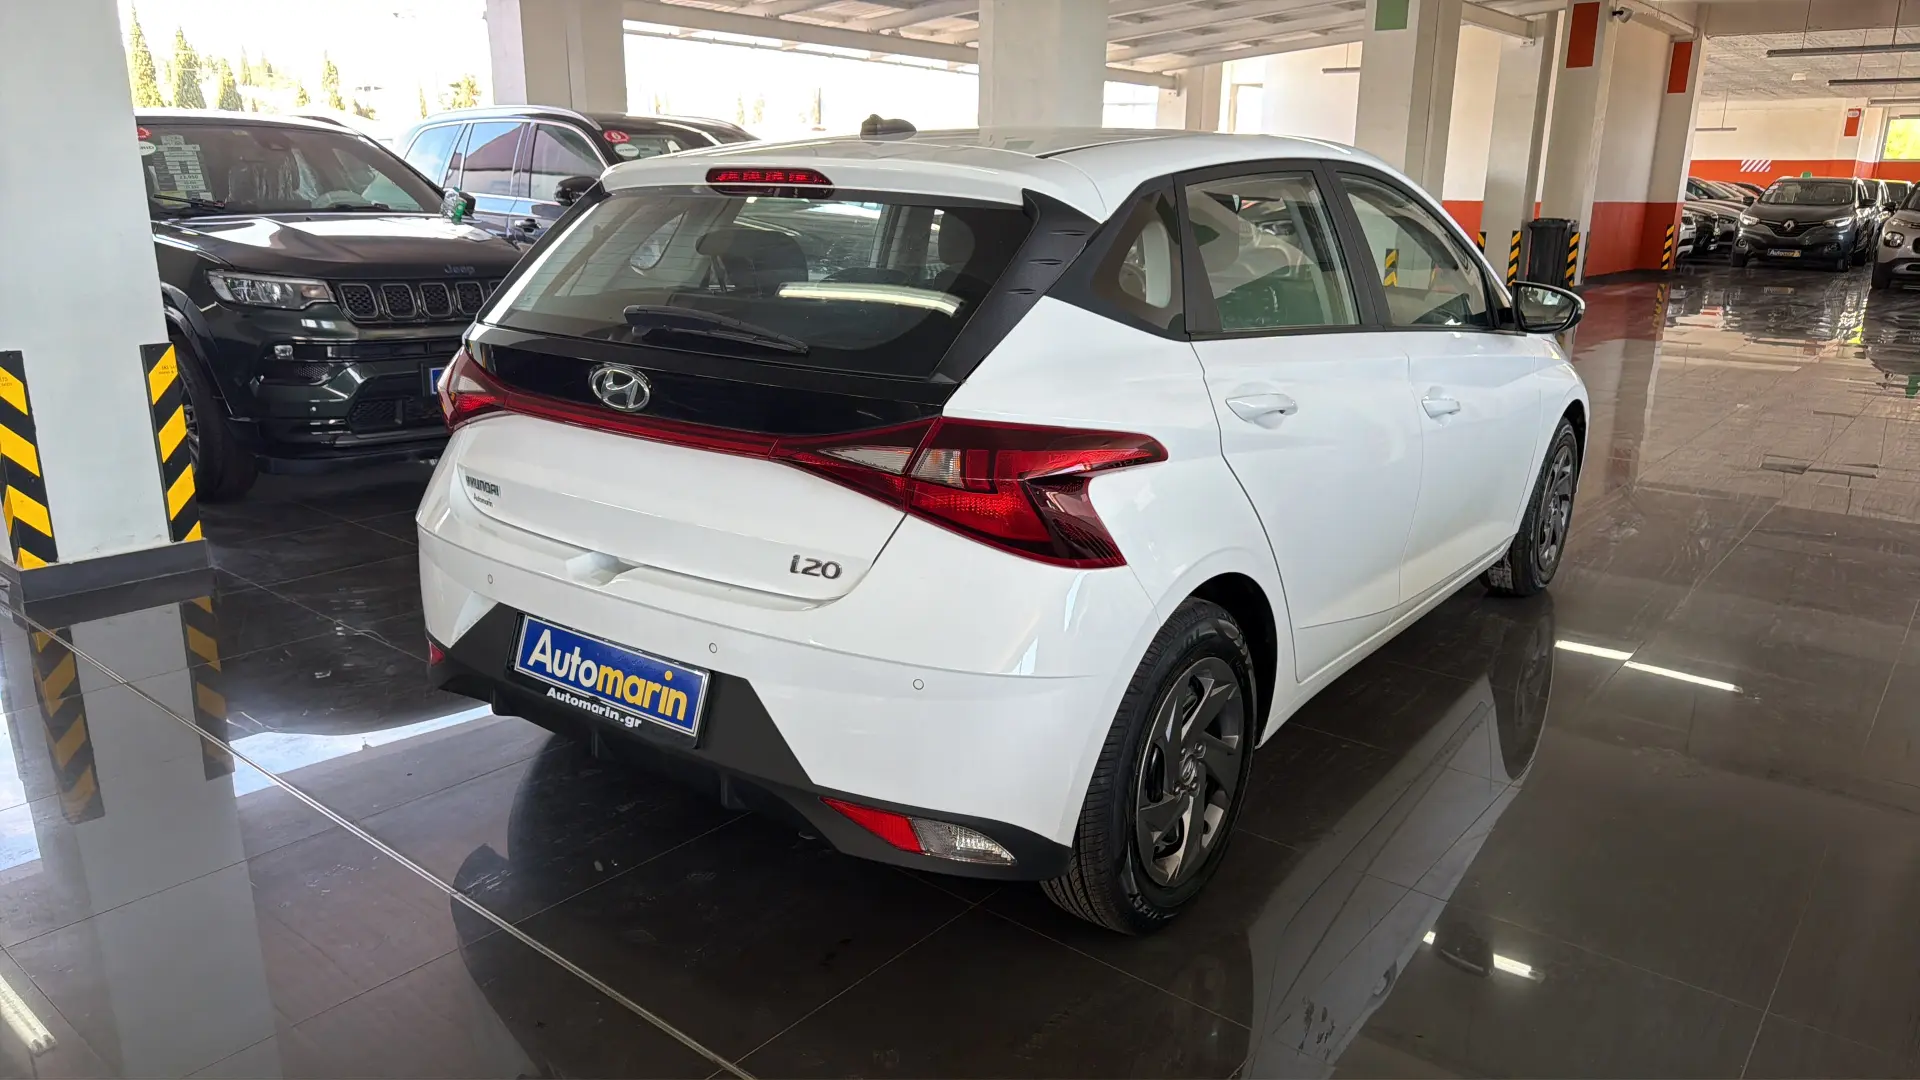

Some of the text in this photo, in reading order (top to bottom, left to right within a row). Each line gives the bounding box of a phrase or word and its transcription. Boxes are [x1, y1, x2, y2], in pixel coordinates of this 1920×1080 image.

[444, 263, 475, 276] Jeep
[465, 475, 500, 497] HYUNDAI
[527, 629, 688, 721] Automarin
[546, 686, 643, 729] Automarin.gr
